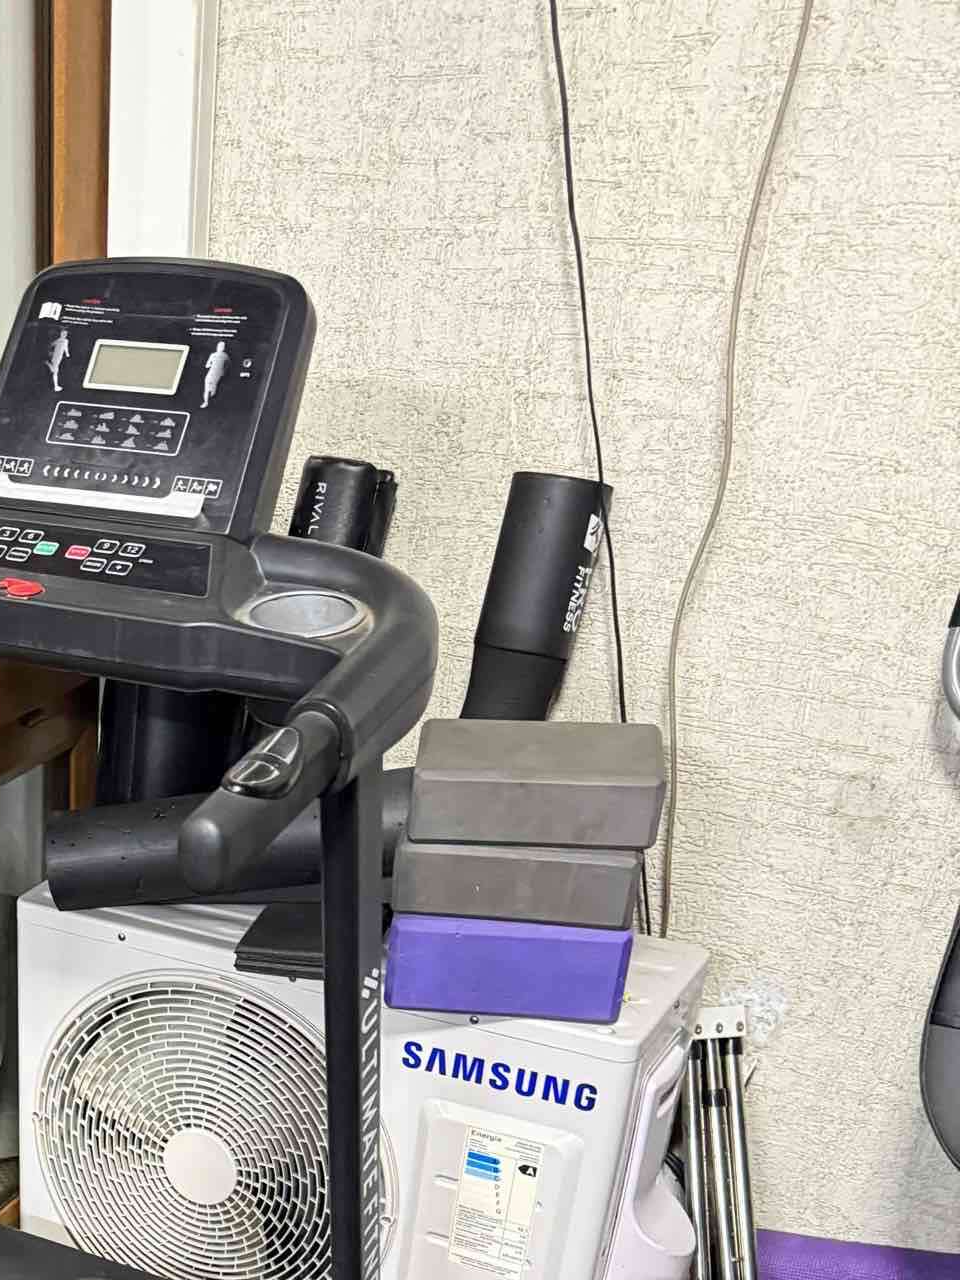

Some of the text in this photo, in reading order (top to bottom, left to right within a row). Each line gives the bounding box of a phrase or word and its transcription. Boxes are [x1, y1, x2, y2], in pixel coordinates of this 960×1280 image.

[307, 482, 327, 536] RIVAL
[126, 545, 138, 554] 12
[563, 565, 586, 632] FITNESS
[361, 998, 379, 1193] ULTIMATE
[401, 1040, 599, 1112] SAMSUNG
